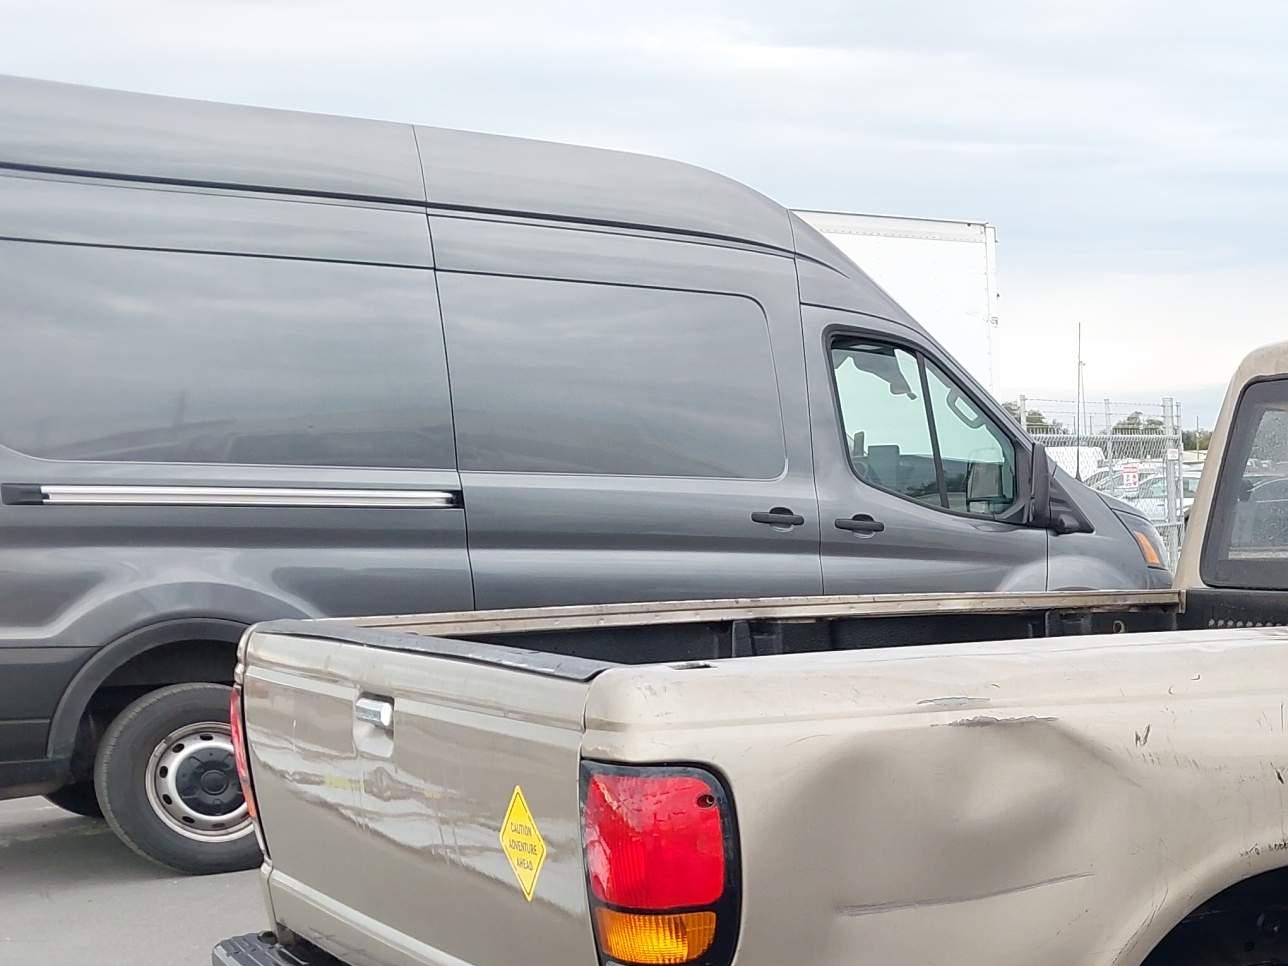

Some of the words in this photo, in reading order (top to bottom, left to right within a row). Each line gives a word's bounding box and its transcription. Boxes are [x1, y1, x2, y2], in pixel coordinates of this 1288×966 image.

[510, 822, 532, 837] CAUTION
[509, 840, 537, 855] ADVENTURE
[516, 858, 533, 870] AHEAD
